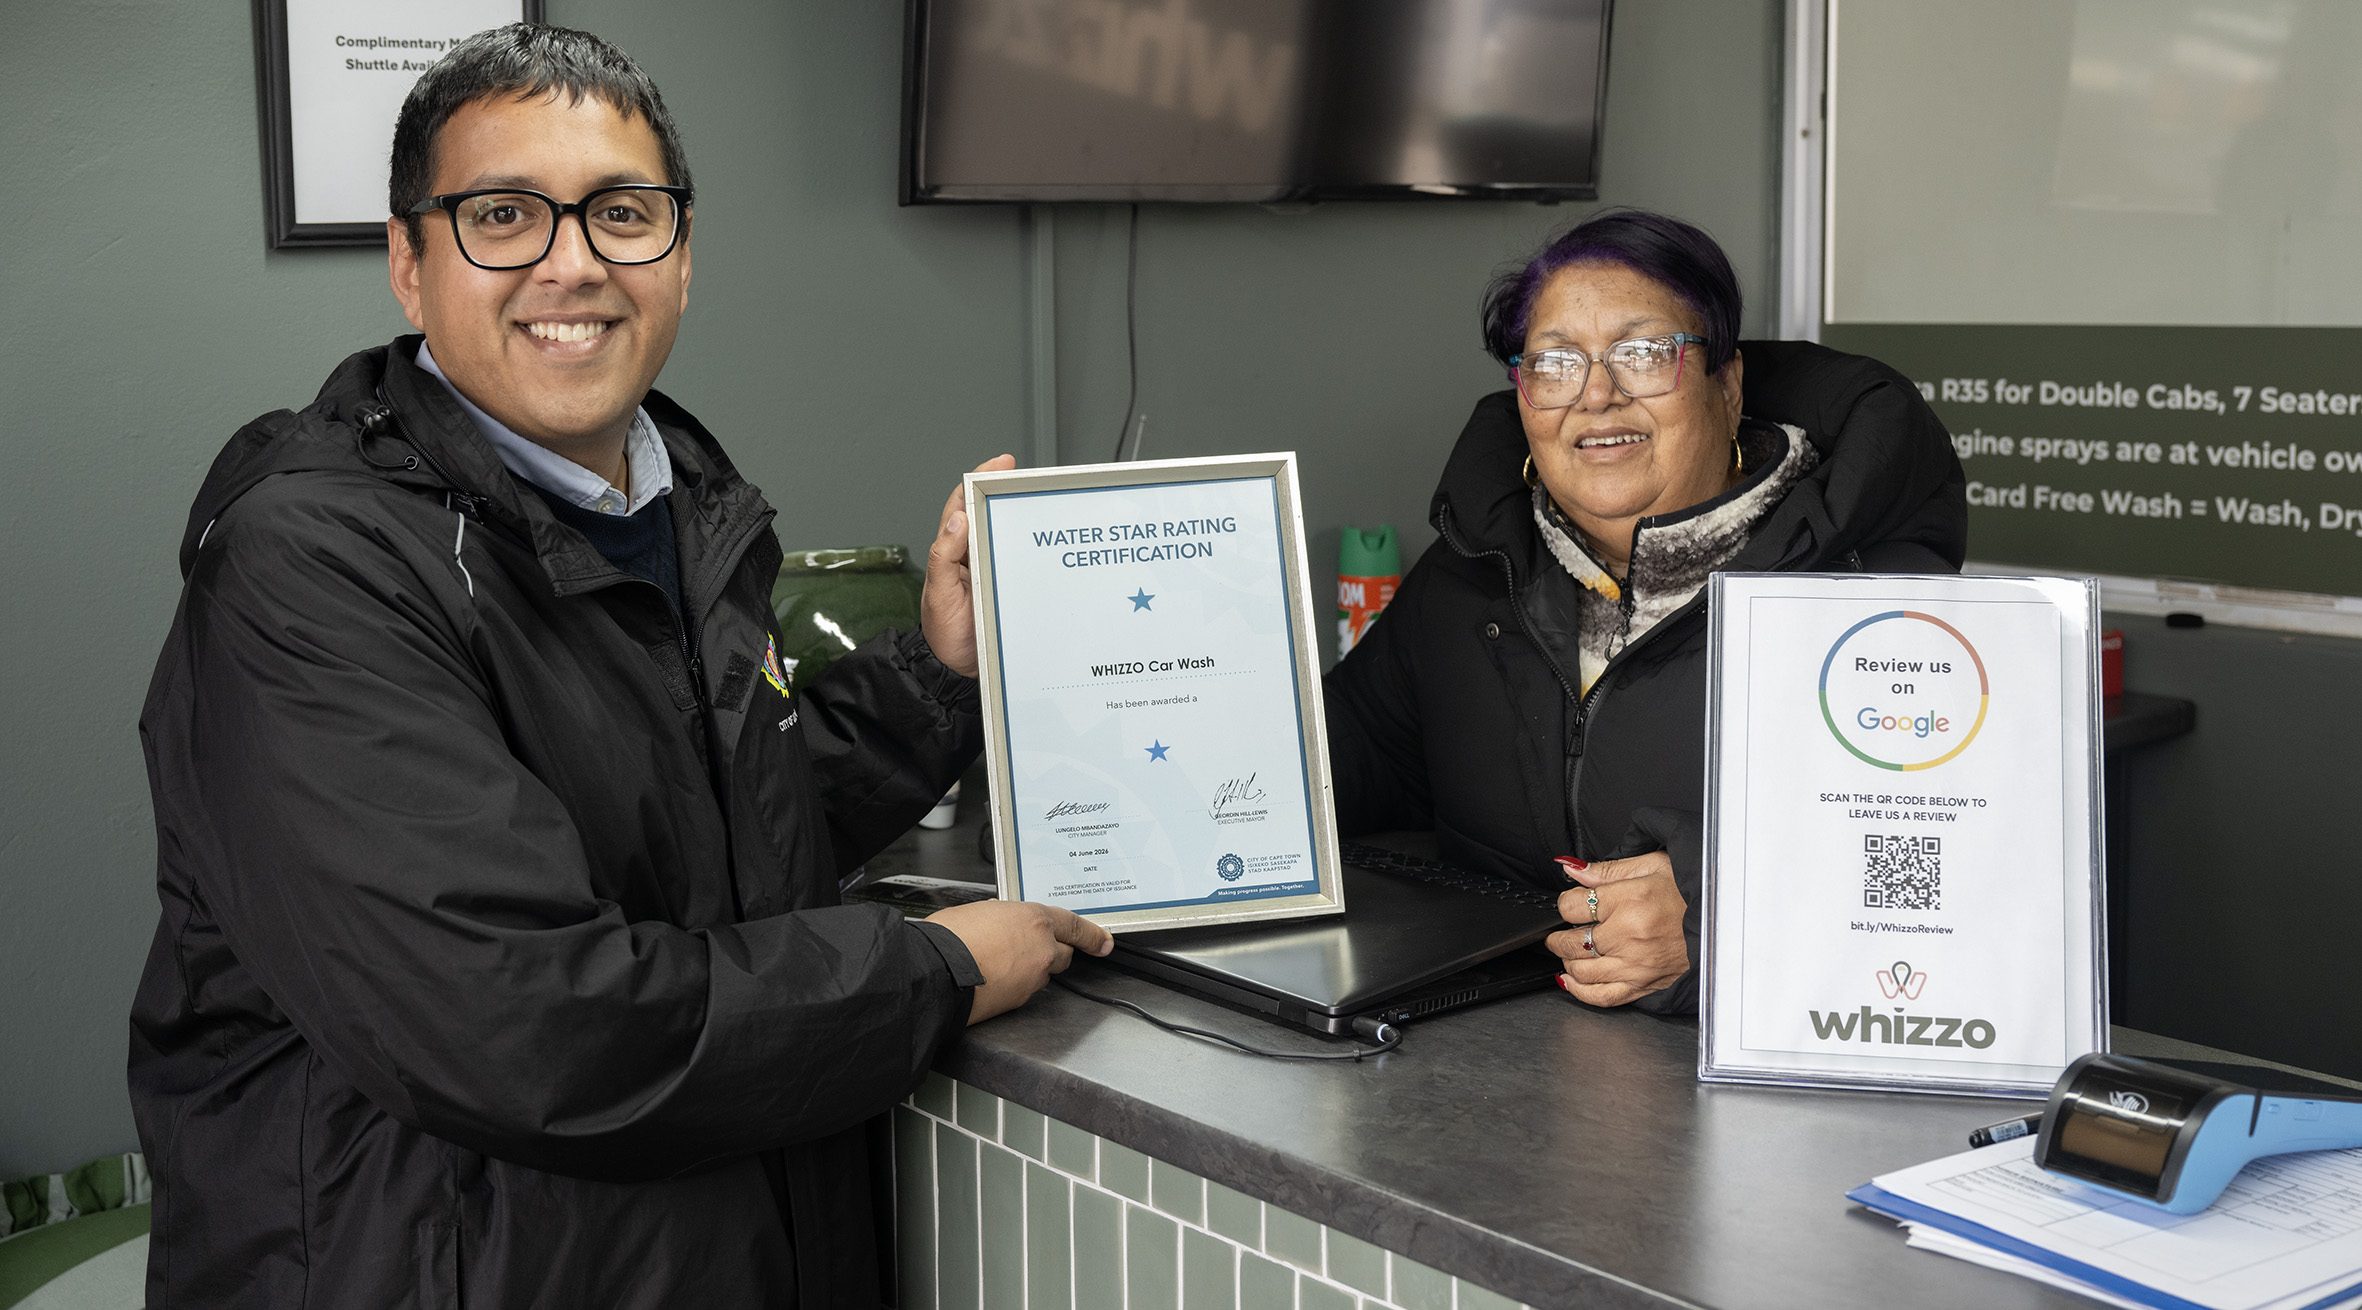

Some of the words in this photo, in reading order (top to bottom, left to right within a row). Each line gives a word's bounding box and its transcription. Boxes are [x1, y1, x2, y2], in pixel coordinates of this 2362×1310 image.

[335, 35, 446, 51] Complimentary
[345, 58, 398, 71] Shuttle
[1941, 378, 1990, 403] R35
[1994, 377, 2033, 404] for
[2039, 380, 2140, 408] Double
[2146, 383, 2226, 416] Cabs,
[2233, 385, 2252, 412] 7
[2259, 386, 2362, 416] Seater
[2019, 436, 2110, 465] sprays
[2115, 440, 2162, 464] are
[2168, 440, 2199, 465] at
[2205, 440, 2317, 471] vehicle
[1966, 481, 2027, 508] Card
[2033, 485, 2094, 513] Free
[2100, 489, 2183, 519] Wash
[2190, 499, 2208, 516] =
[2215, 496, 2310, 532] Wash,
[1032, 527, 1104, 547] WATER
[1109, 523, 1158, 542] STAR
[1163, 516, 1236, 538] RATING
[1061, 541, 1213, 568] CERTIFICATION
[1091, 662, 1145, 677] WHIZZO
[1148, 660, 1174, 672] Car
[1177, 656, 1215, 670] Wash
[1855, 657, 1923, 673] Review
[1930, 662, 1952, 673] us
[1891, 682, 1915, 695] on
[1106, 701, 1123, 710] Has
[1125, 699, 1148, 708] been
[1151, 694, 1190, 706] awarded
[1192, 695, 1198, 703] a
[1857, 707, 1950, 738] Google
[1819, 793, 1850, 803] SCAN
[1852, 793, 1874, 804] THE
[1876, 794, 1893, 805] QR
[1895, 795, 1926, 806] CODE
[1929, 796, 1969, 808] BELOW
[1971, 798, 1987, 808] TO
[1849, 809, 1883, 820] LEAVE
[1885, 810, 1900, 821] US
[1902, 811, 1911, 821] A
[1913, 811, 1957, 822] REVIEW
[1064, 882, 1100, 890] CERTIFICATION
[1850, 921, 1954, 935] bit.ly/WhizzoReview
[1808, 1005, 1996, 1049] whizzo
